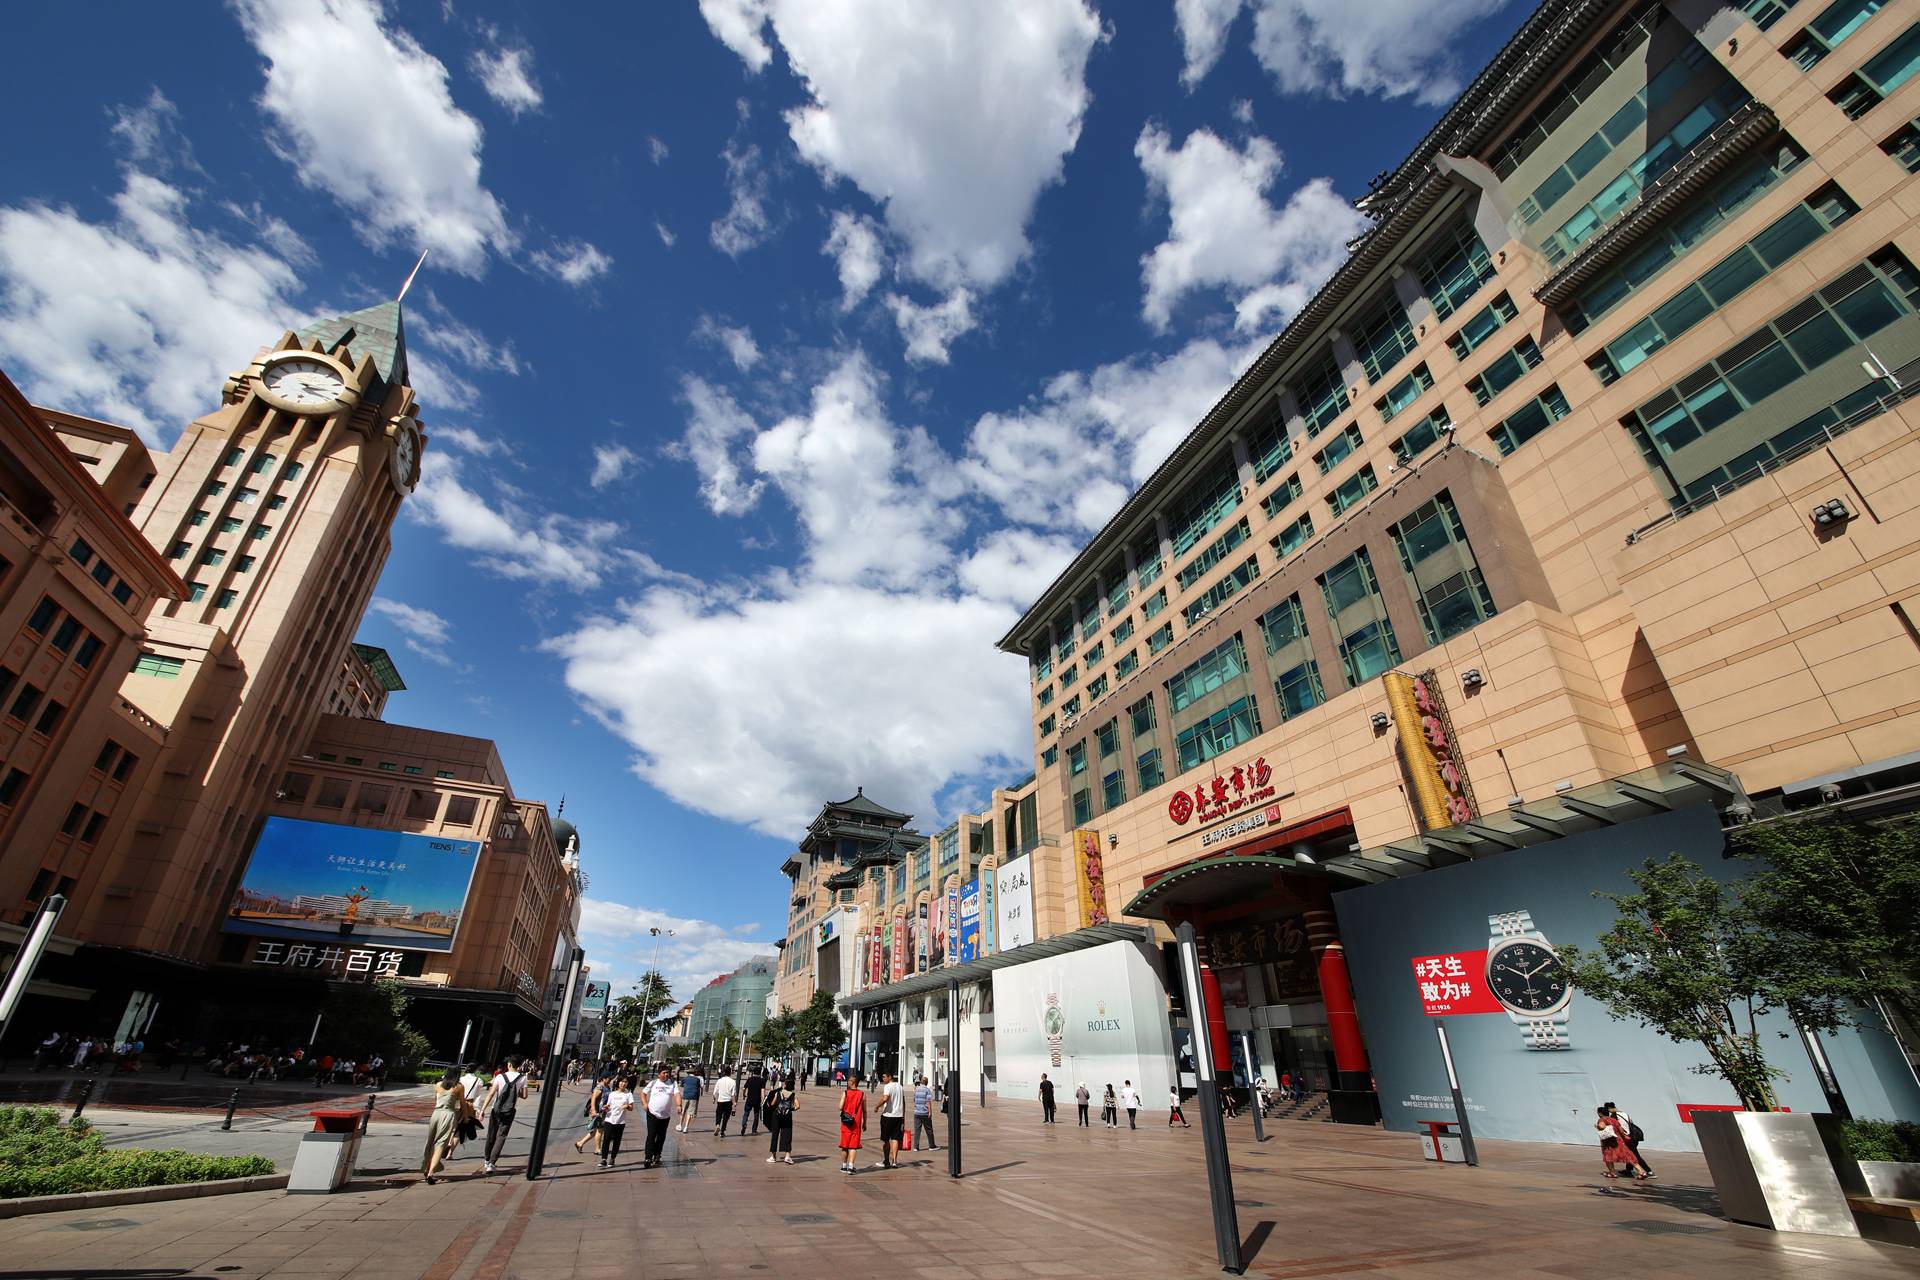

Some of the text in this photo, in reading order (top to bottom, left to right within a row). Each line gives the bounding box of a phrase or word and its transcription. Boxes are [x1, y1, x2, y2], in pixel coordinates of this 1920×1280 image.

[428, 841, 452, 852] TIENS
[252, 941, 405, 976] 王府井百货
[1415, 956, 1466, 979] #天生
[1420, 980, 1472, 1002] 敢为#
[1087, 1018, 1121, 1032] ROLEX
